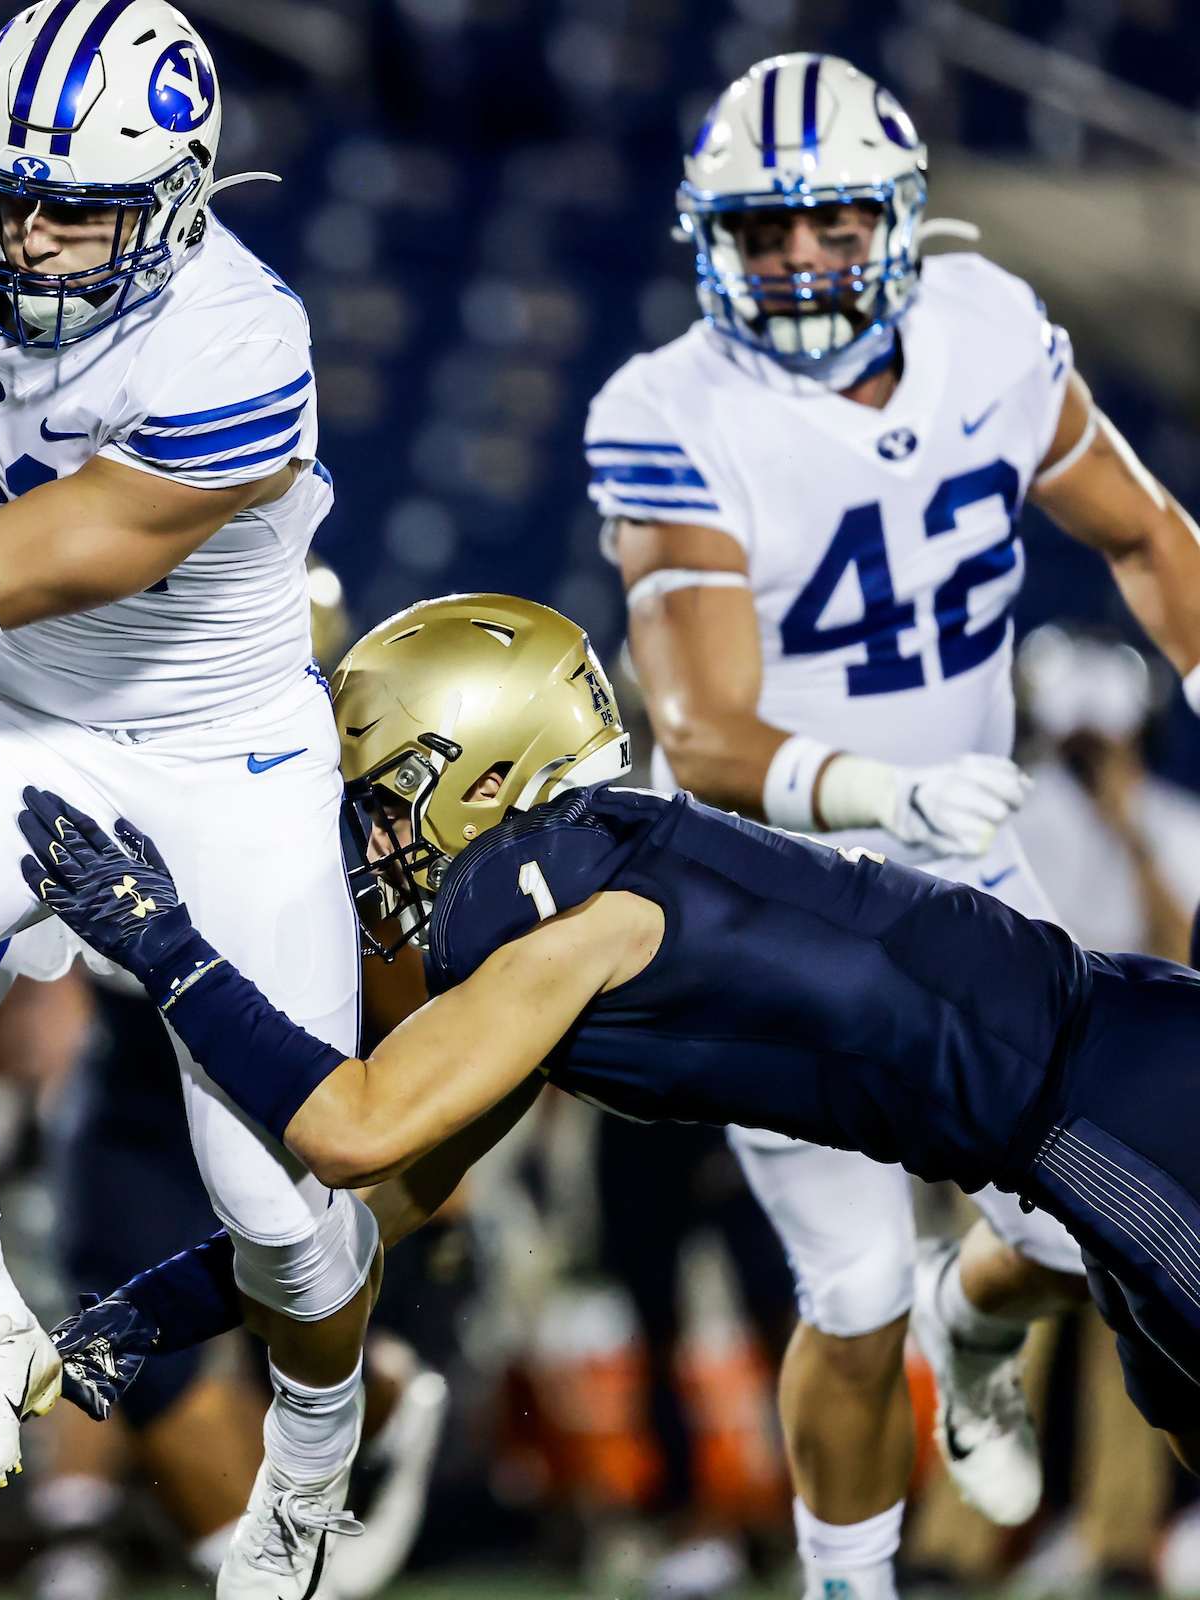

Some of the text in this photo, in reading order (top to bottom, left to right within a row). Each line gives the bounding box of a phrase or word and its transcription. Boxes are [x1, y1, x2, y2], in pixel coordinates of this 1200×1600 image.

[780, 458, 1019, 696] 42
[600, 708, 614, 728] P6
[518, 860, 557, 921] 1
[175, 981, 190, 996] Christ
[188, 972, 200, 983] Who
